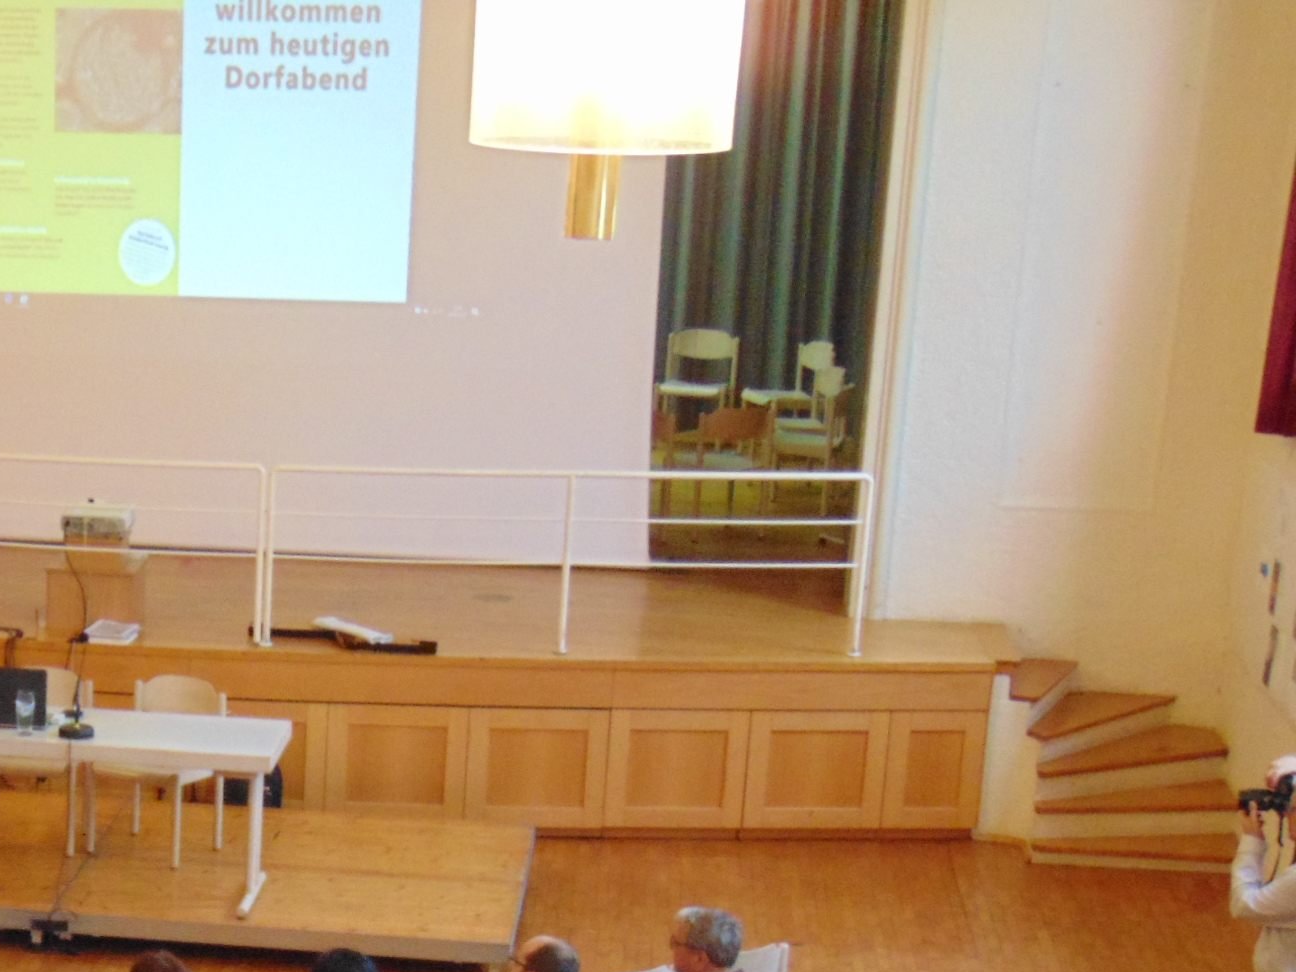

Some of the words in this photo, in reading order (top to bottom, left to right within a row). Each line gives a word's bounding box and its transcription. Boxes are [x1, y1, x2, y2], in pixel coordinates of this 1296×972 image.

[215, 0, 382, 23] willkommen
[204, 36, 259, 56] zum
[270, 31, 390, 65] heutigen
[225, 65, 368, 91] Dorfabend
